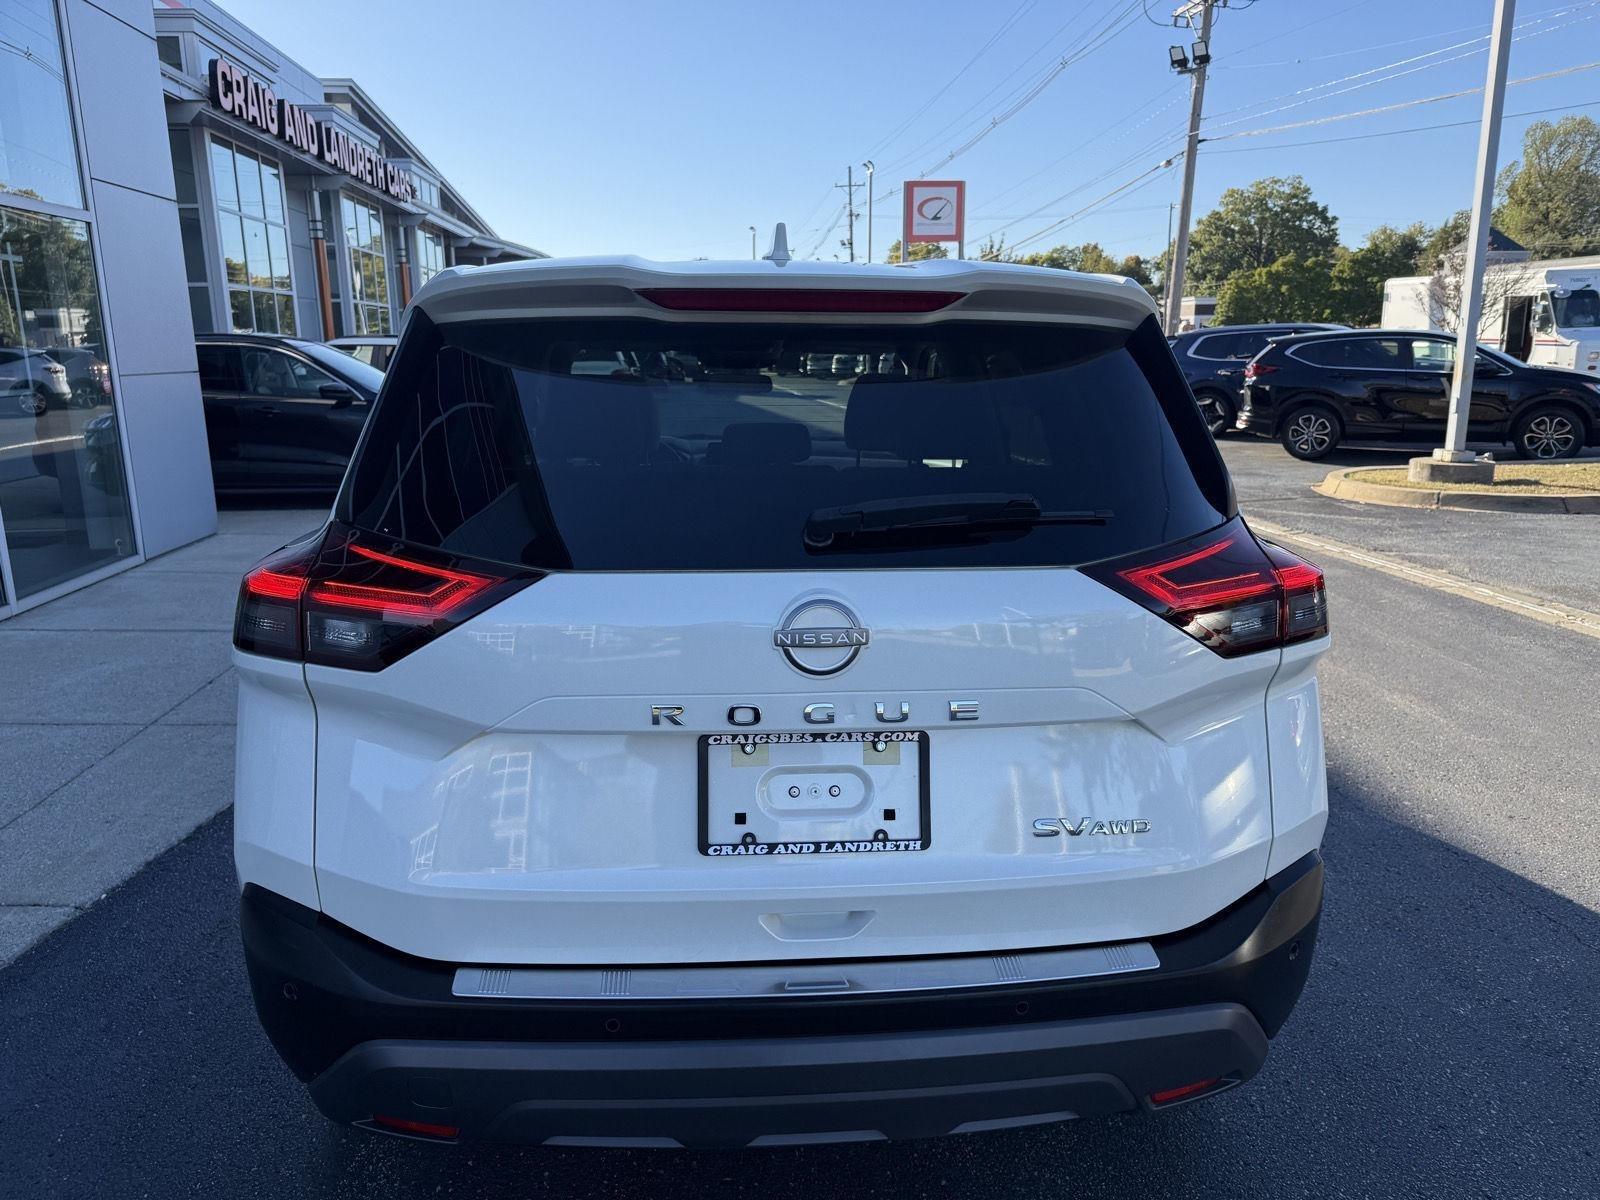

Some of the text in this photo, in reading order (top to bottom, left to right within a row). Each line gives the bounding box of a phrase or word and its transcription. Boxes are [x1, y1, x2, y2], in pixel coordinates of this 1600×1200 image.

[216, 58, 412, 203] CRAIG AND LANDRETH CARS
[777, 631, 867, 645] NISSAN
[650, 700, 980, 727] ROGUE
[1089, 818, 1152, 836] AWD
[707, 840, 922, 856] CRAIG AND LANDRETH
